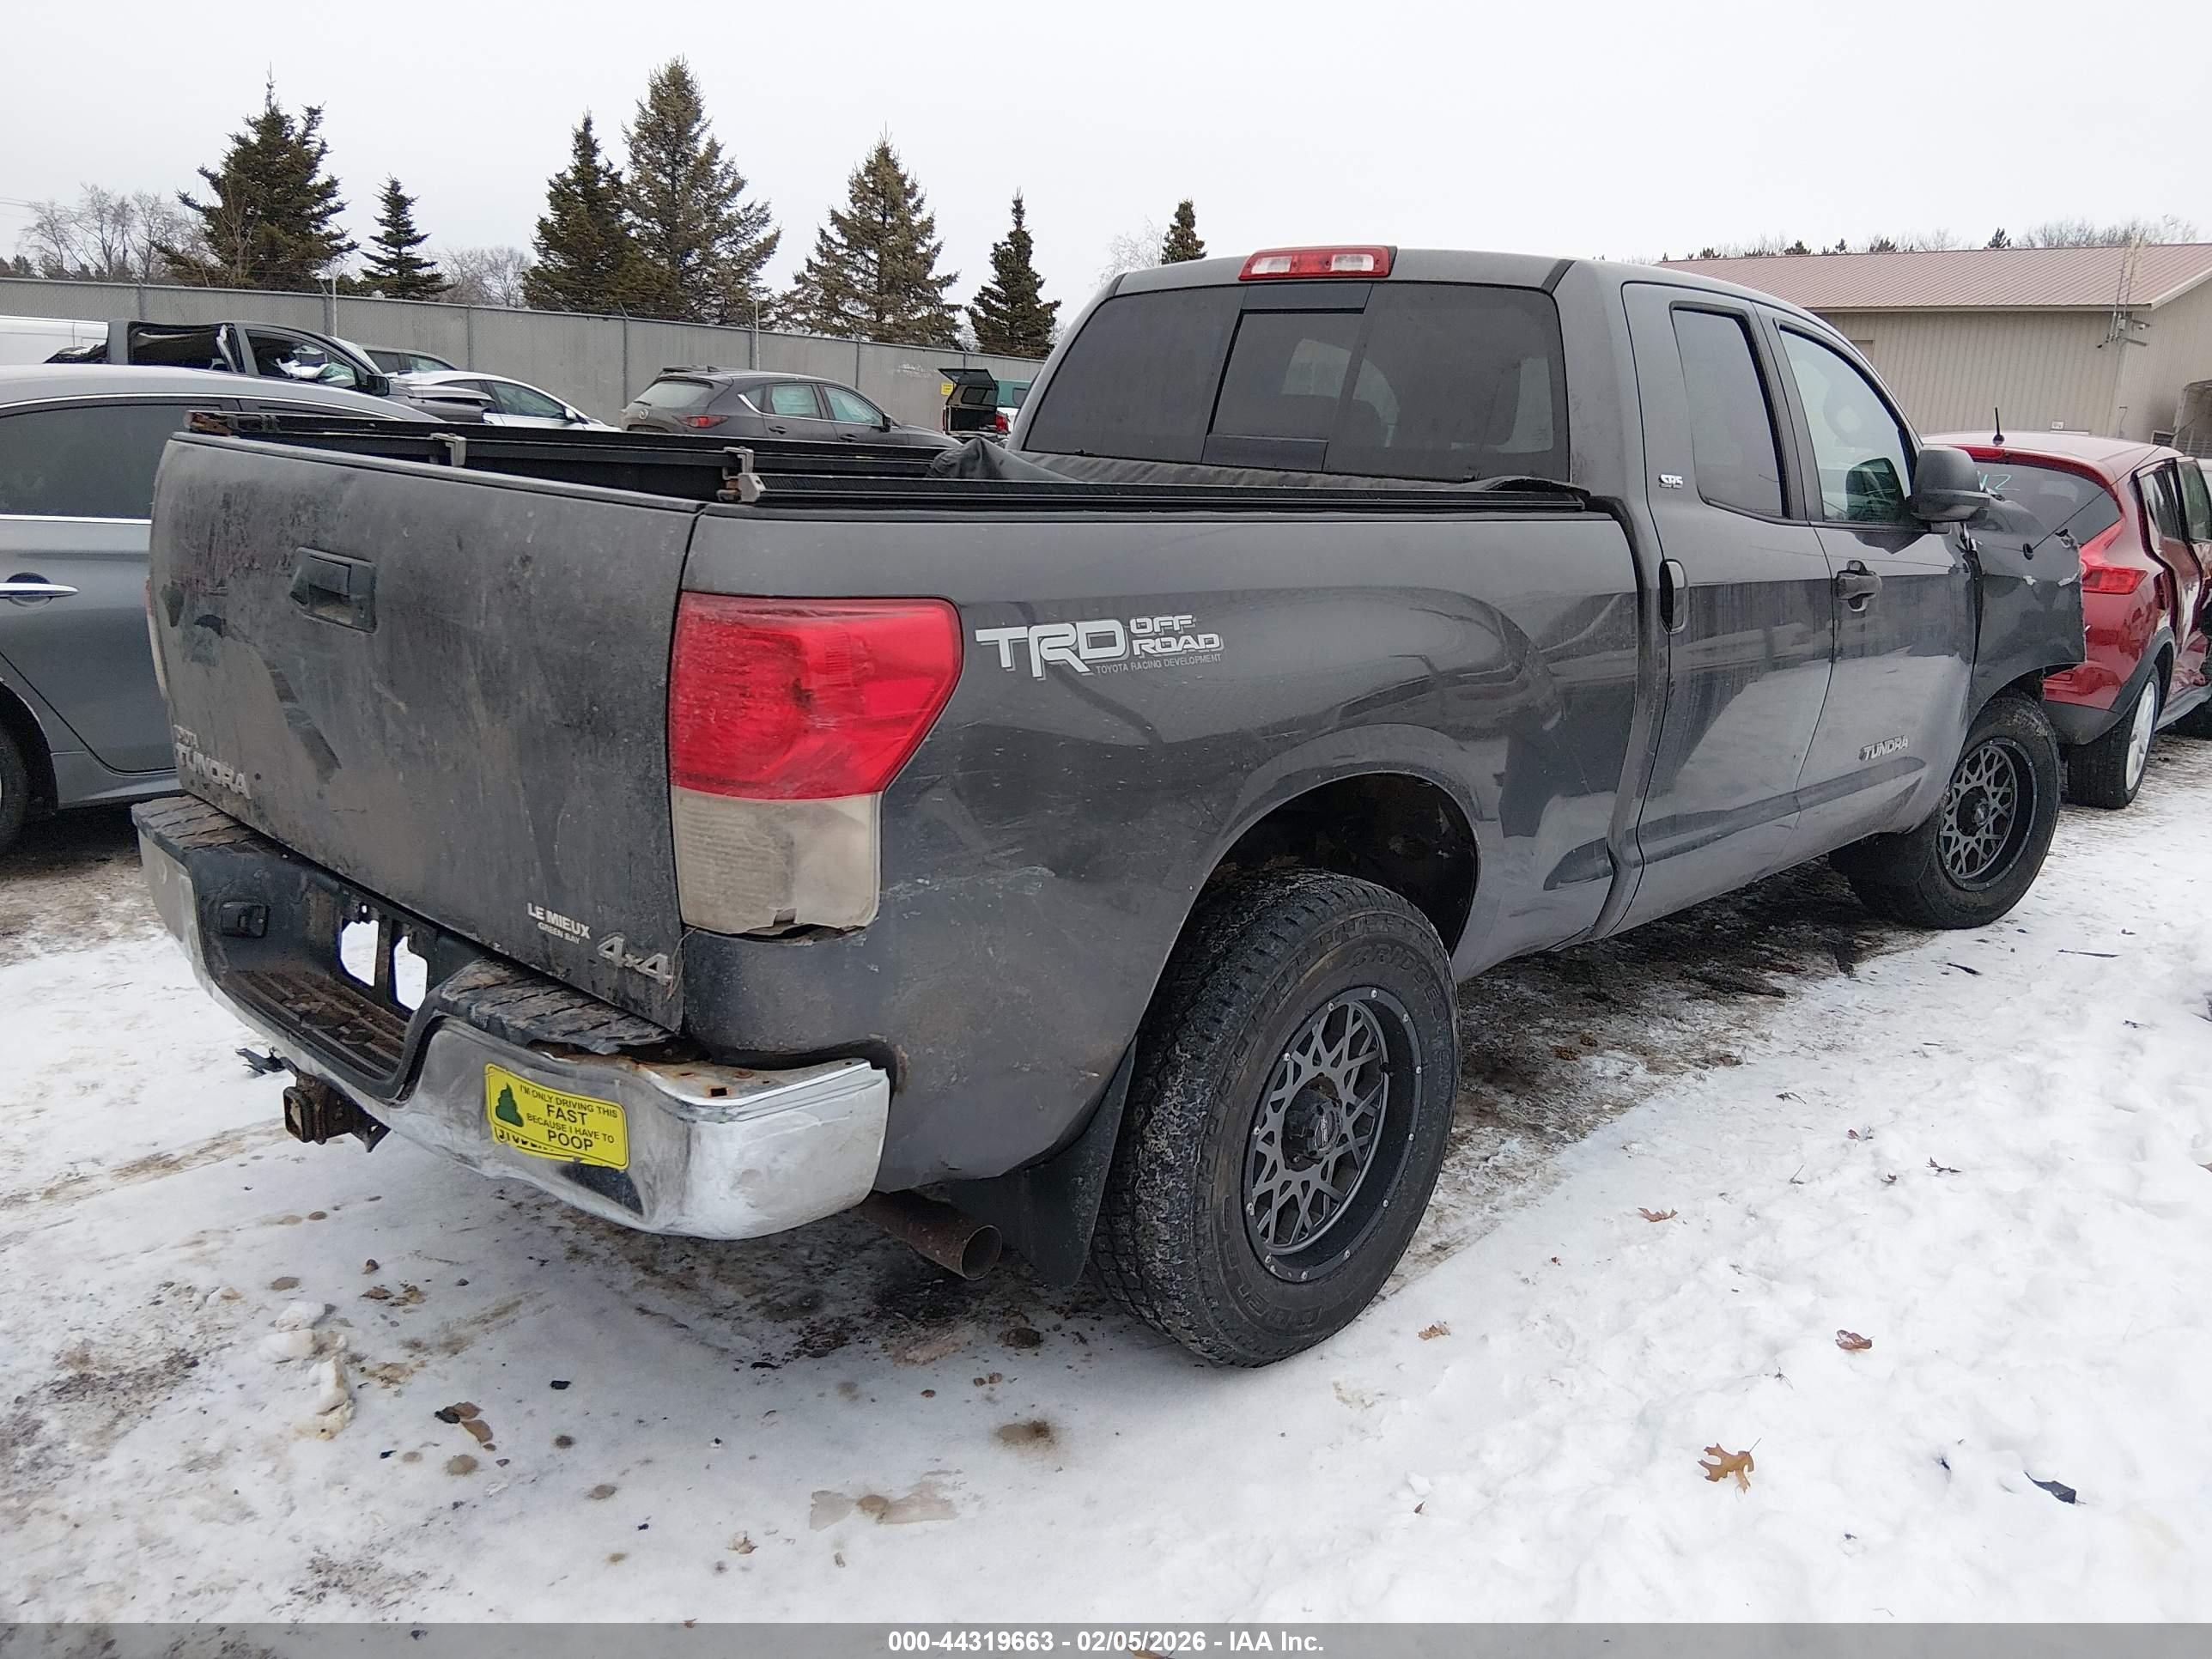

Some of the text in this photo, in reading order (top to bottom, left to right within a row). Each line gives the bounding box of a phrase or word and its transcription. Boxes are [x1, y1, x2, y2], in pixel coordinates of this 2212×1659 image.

[1129, 614, 1196, 636] OFF
[975, 618, 1130, 681] TRD
[1132, 633, 1224, 659] ROAD
[1095, 653, 1222, 675] TOYOTA RACING DEVELOPMENT
[1859, 735, 1908, 761] TUNDRA
[175, 741, 252, 800] TUNDRA
[526, 902, 591, 940] LE MIEUX
[537, 921, 581, 945] GREEN BAY
[596, 933, 675, 986] 4x4
[520, 1084, 618, 1119] I'M ONLY DRIVING THIS
[546, 1103, 588, 1126] FAST
[526, 1112, 567, 1133] BECAUSE
[574, 1127, 600, 1140] HAVE
[602, 1132, 615, 1144] TO
[547, 1129, 593, 1152] POOP
